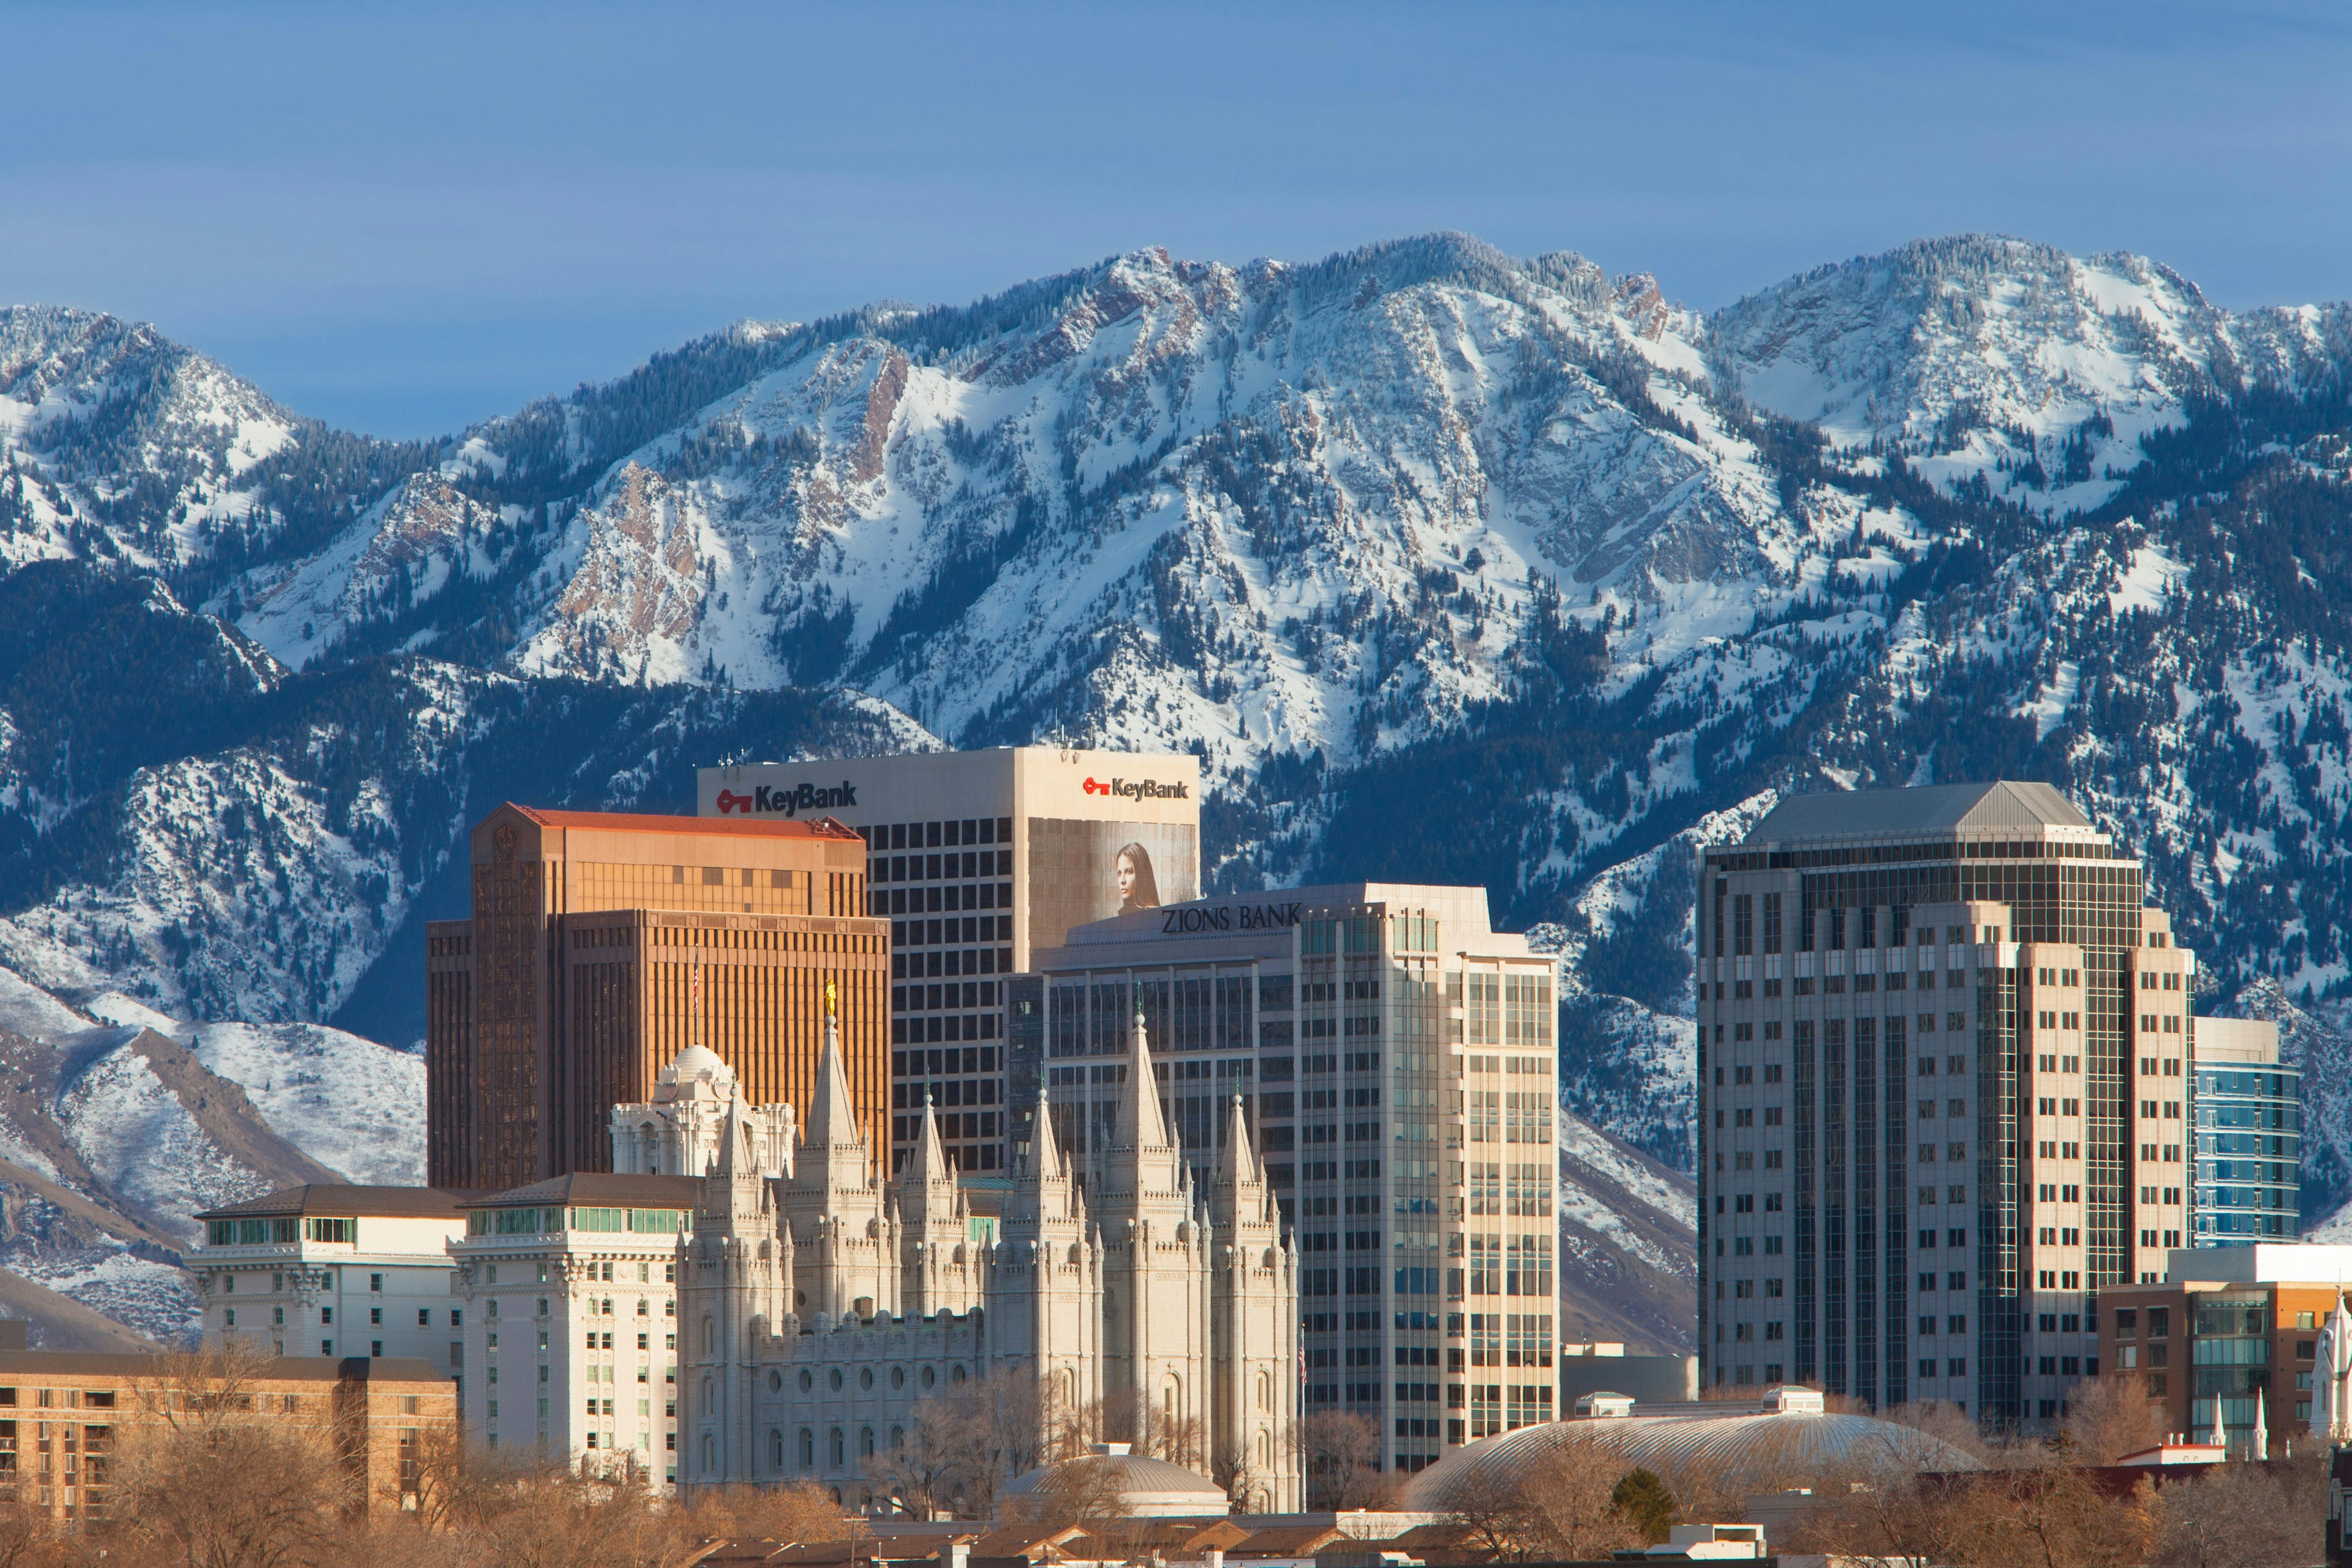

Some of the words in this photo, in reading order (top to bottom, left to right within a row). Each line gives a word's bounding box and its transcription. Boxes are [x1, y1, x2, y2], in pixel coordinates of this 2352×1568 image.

[755, 780, 857, 817] KeyBank
[1112, 778, 1189, 802] KeyBank
[1161, 907, 1231, 933] ZIONS
[1238, 902, 1303, 929] BANK
